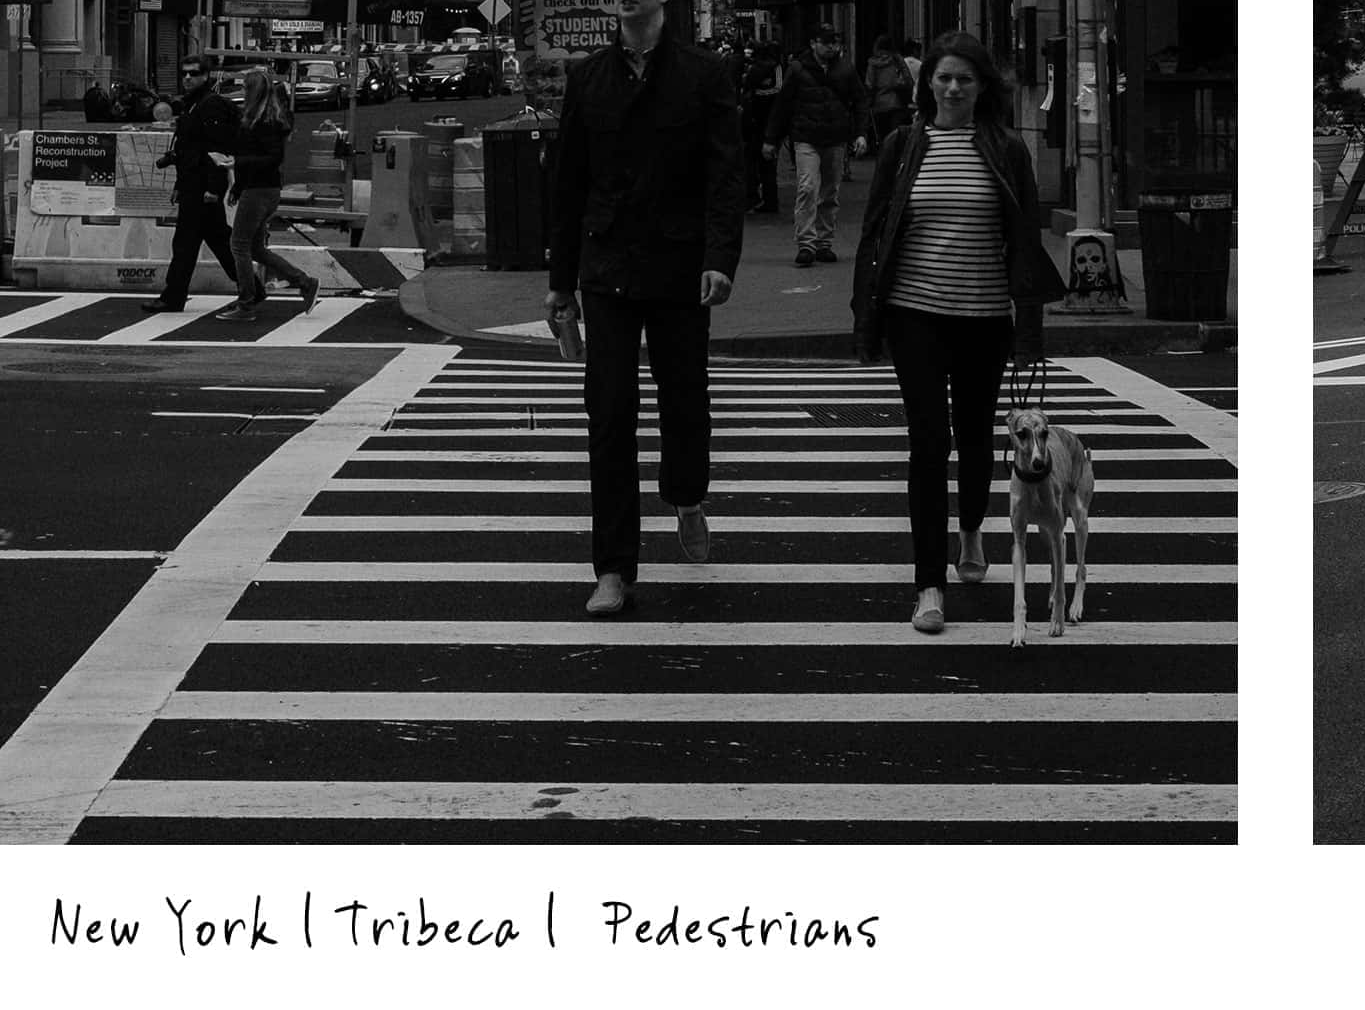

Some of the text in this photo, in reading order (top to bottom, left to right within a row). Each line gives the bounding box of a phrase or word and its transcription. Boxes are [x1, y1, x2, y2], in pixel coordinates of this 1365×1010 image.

[545, 16, 618, 33] STUDENTS
[552, 33, 612, 46] SPECIAL
[36, 134, 99, 145] Chambers St.
[36, 145, 106, 157] Reconstruction
[35, 157, 69, 168] Project
